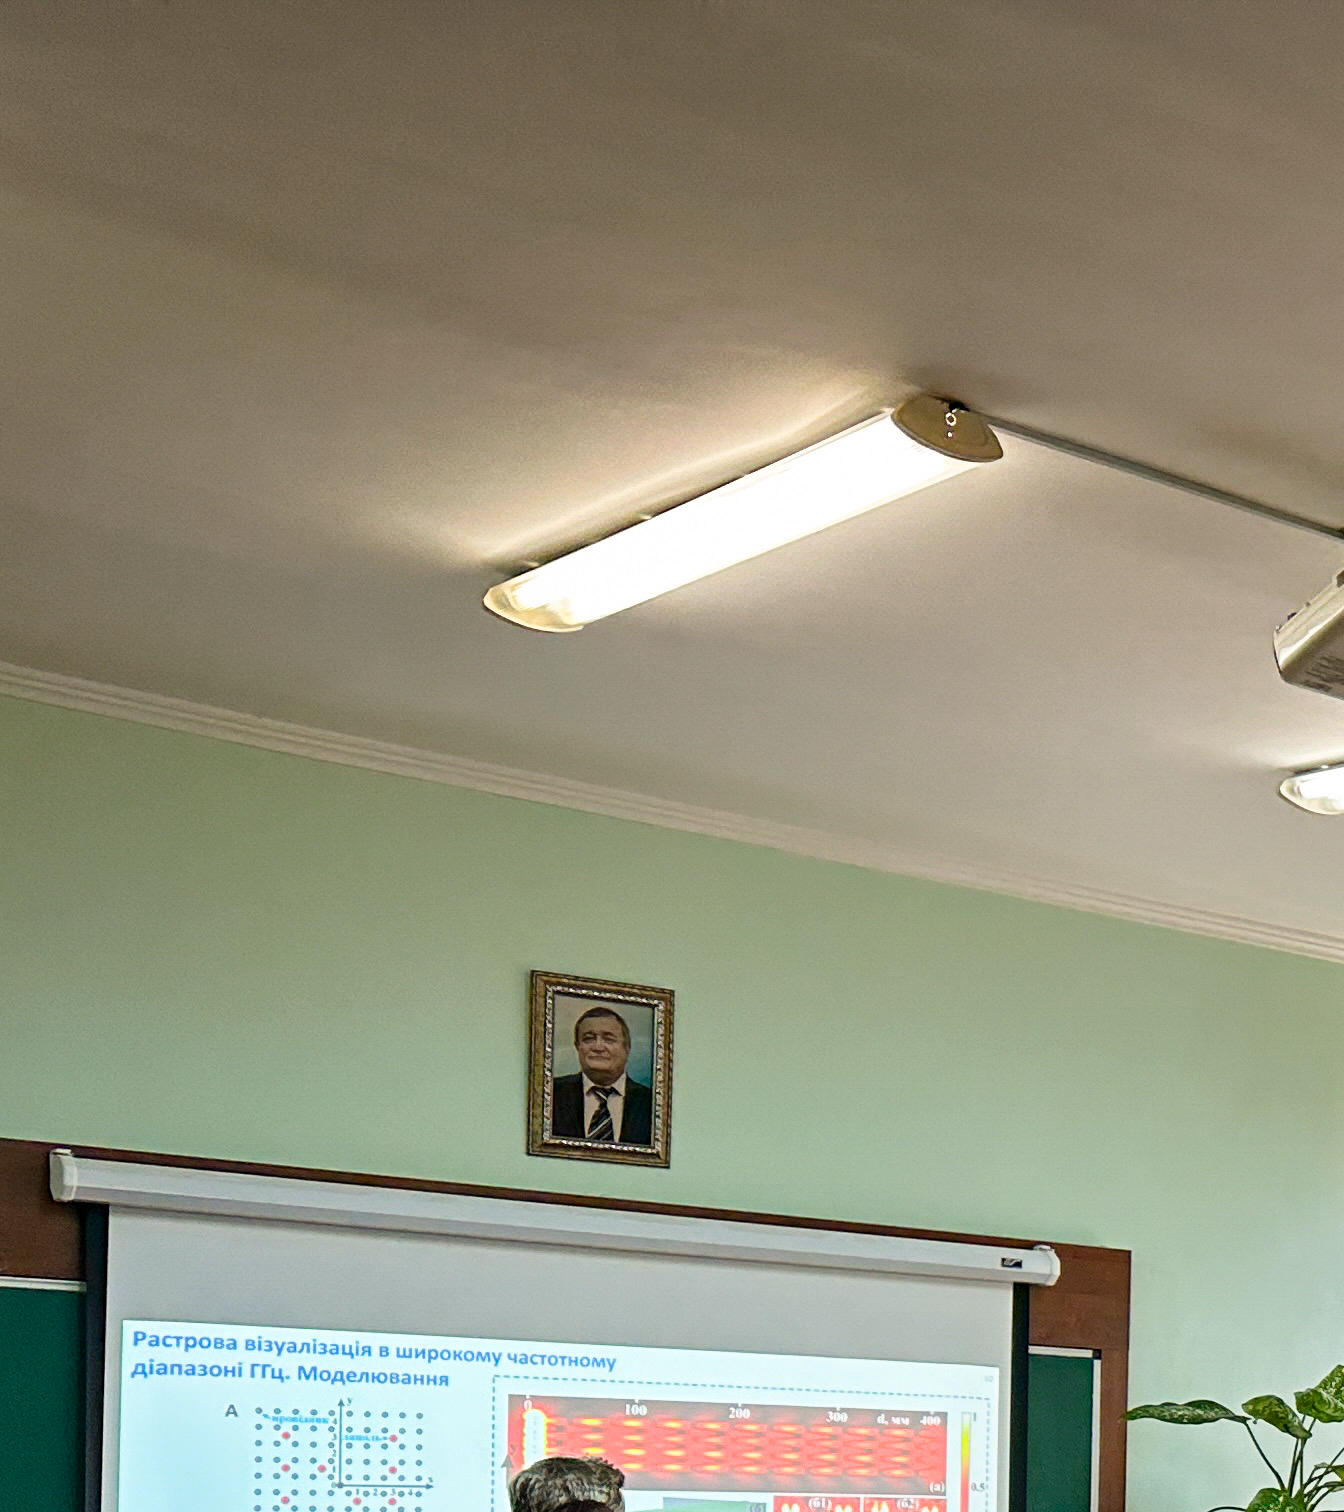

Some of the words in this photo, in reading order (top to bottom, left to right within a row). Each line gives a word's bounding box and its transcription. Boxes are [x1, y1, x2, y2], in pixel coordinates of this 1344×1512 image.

[132, 1330, 238, 1352] Растрова
[244, 1335, 373, 1360] візуалізація
[379, 1345, 390, 1358] в
[396, 1346, 503, 1367] широкому
[507, 1351, 617, 1372] частотному
[130, 1358, 244, 1379] діапазоні
[249, 1362, 291, 1383] ГГц.
[297, 1365, 450, 1387] Моделювання
[624, 1403, 649, 1416] 100
[728, 1407, 751, 1419] 200
[825, 1411, 848, 1423] 300
[919, 1415, 941, 1427] 400
